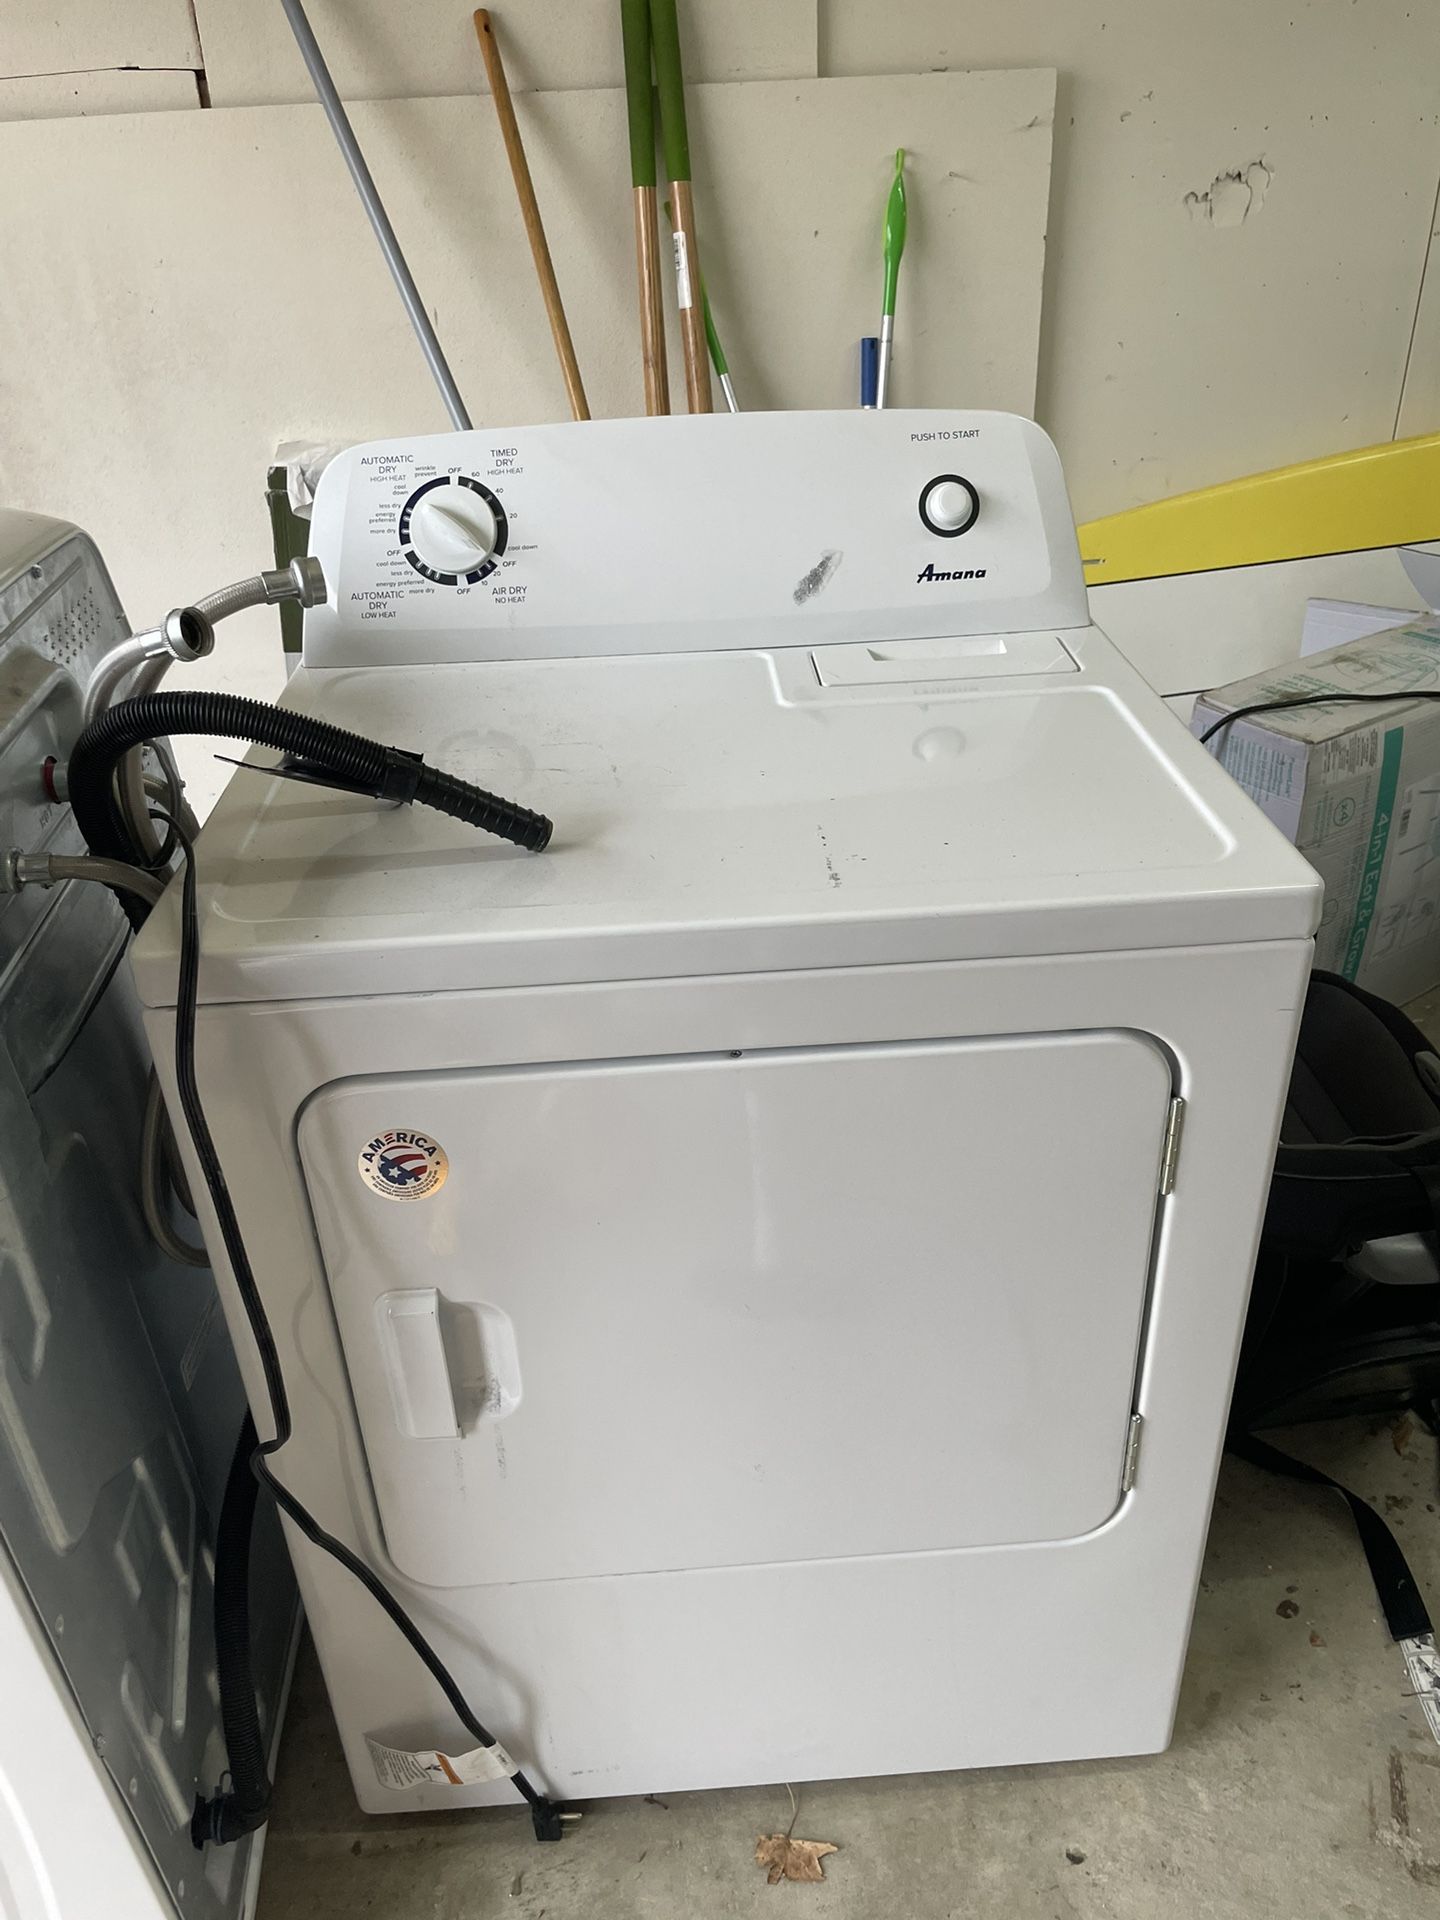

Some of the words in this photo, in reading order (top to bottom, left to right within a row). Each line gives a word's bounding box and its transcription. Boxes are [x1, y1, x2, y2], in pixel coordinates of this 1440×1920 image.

[911, 432, 935, 442] PUSH
[938, 432, 950, 440] TO
[952, 430, 980, 439] START
[491, 449, 518, 457] TIMED
[361, 455, 413, 465] AUTOMATIC
[496, 459, 514, 467] DRY
[379, 466, 397, 474] DRY
[917, 563, 987, 584] Amana
[351, 590, 404, 601] AUTOMATIC
[492, 587, 507, 595] AIR
[509, 586, 527, 594] DRY
[1369, 813, 1390, 866] 4-In-1
[1361, 871, 1378, 902] Eat
[1359, 908, 1371, 921] &
[362, 1132, 437, 1163] AMERICA
